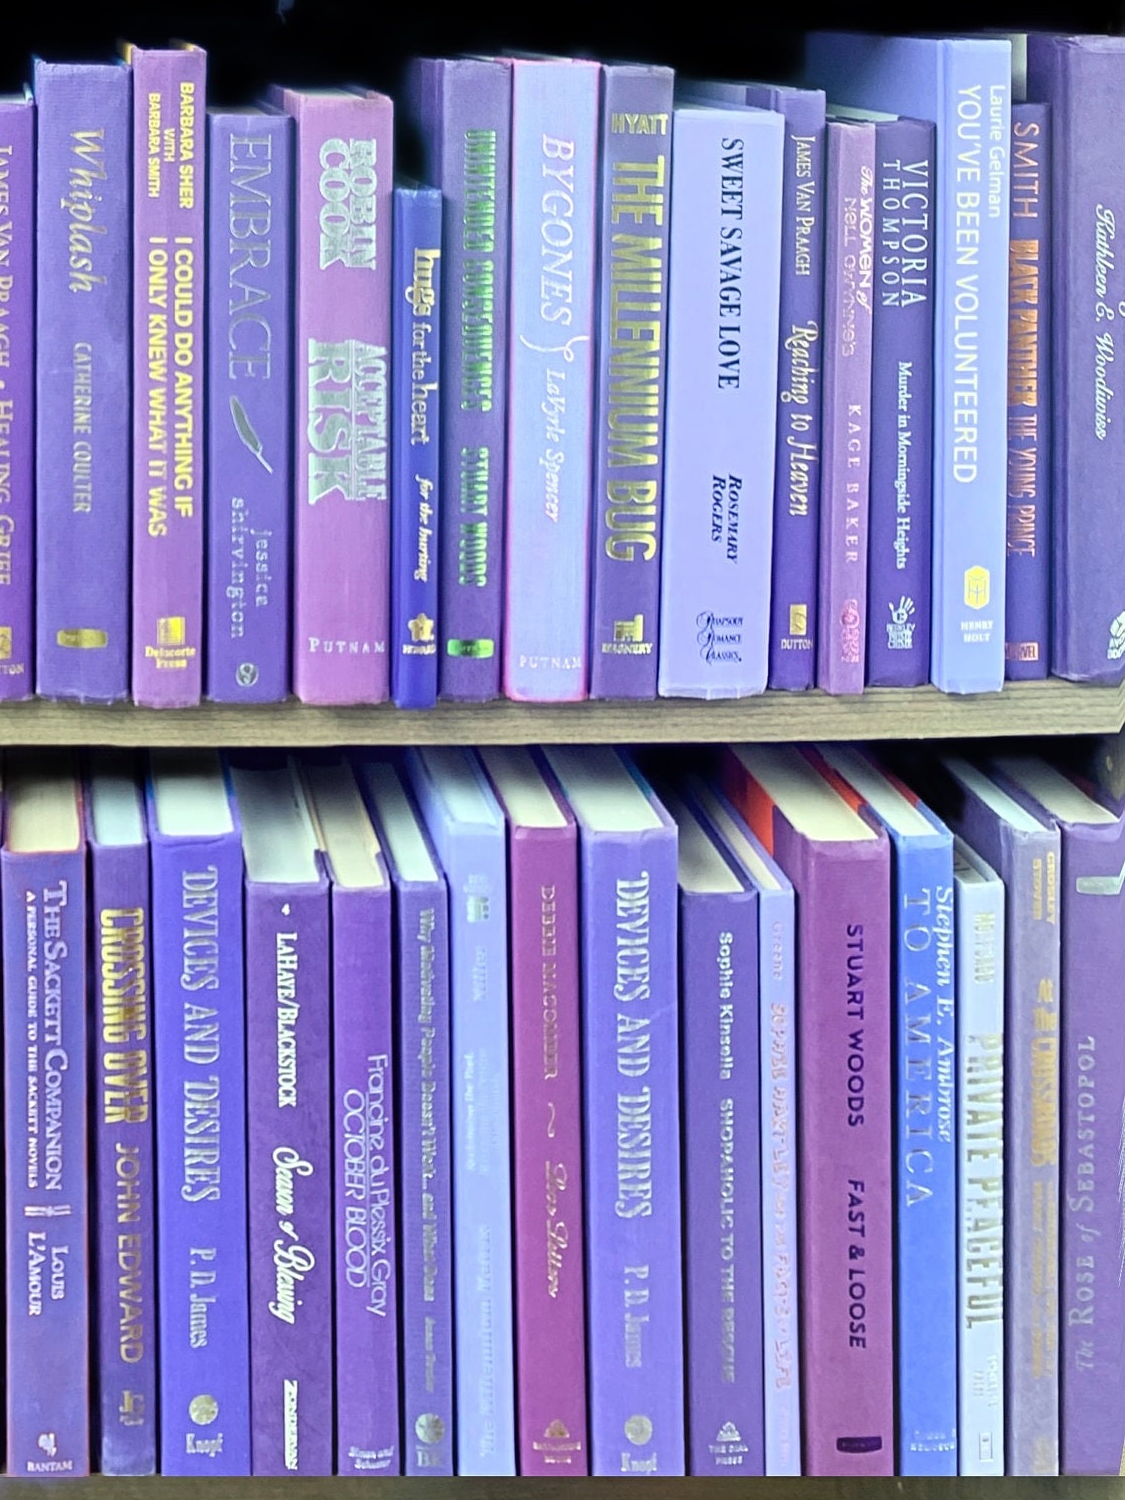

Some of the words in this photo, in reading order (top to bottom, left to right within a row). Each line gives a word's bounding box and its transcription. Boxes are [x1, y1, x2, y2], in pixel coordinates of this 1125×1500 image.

[956, 84, 983, 183] YOU'VE
[611, 154, 666, 226] THE
[720, 137, 745, 221] SWEET
[228, 132, 272, 381] EMBRACE
[955, 191, 981, 265] BEEN
[719, 227, 743, 317] SAVAGE
[608, 233, 663, 466] MILLENNIUM
[717, 325, 741, 389] LOVE
[952, 274, 980, 483] VOLUNTEERED
[605, 479, 658, 562] BUG
[613, 870, 651, 1002] DEVICES
[846, 923, 865, 1021] STUART
[616, 1012, 652, 1078] AND
[847, 1028, 865, 1127] WOODS
[115, 1142, 141, 1224] JOHN
[614, 1085, 653, 1219] DESIRES
[847, 1179, 866, 1238] FAST
[848, 1244, 866, 1261] &
[117, 1234, 144, 1364] EDWARD
[848, 1267, 867, 1349] LOOSE
[25, 1460, 73, 1472] BANTAM
